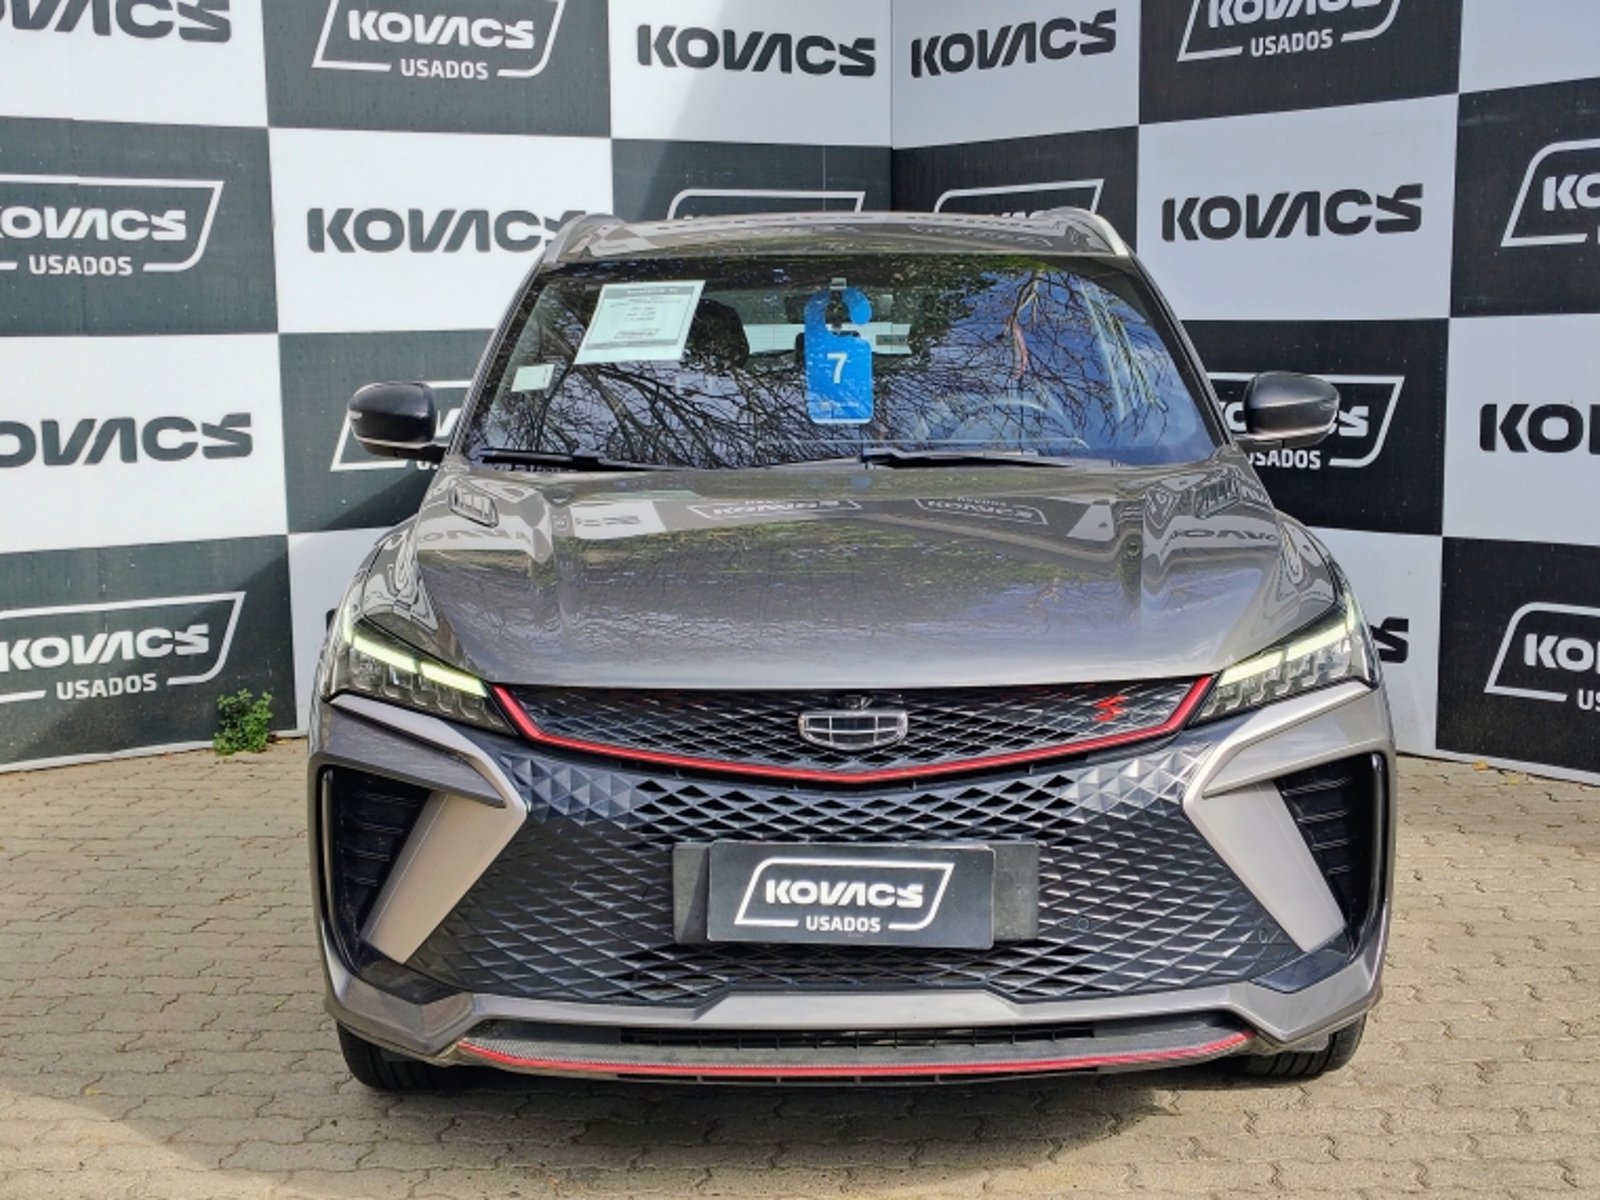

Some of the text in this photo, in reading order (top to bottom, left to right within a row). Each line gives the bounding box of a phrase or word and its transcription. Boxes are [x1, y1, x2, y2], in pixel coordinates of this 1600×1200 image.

[0, 0, 231, 43] VACS
[348, 9, 535, 49] KOVACS
[637, 23, 876, 77] KOVACS
[911, 8, 1116, 78] KOVACS
[1251, 28, 1333, 57] USADOS
[401, 58, 489, 80] USADOS
[0, 206, 187, 241] OVACS
[1162, 183, 1423, 242] KOVACS
[29, 254, 133, 276] USADOS
[826, 352, 848, 384] 7
[1479, 403, 1600, 455] KO
[1250, 449, 1321, 470] SADOS
[0, 623, 209, 672] KOVACS
[1523, 633, 1600, 674] KO
[56, 673, 157, 700] USADOS
[766, 879, 924, 908] KOVACS
[806, 915, 881, 933] USADOS
